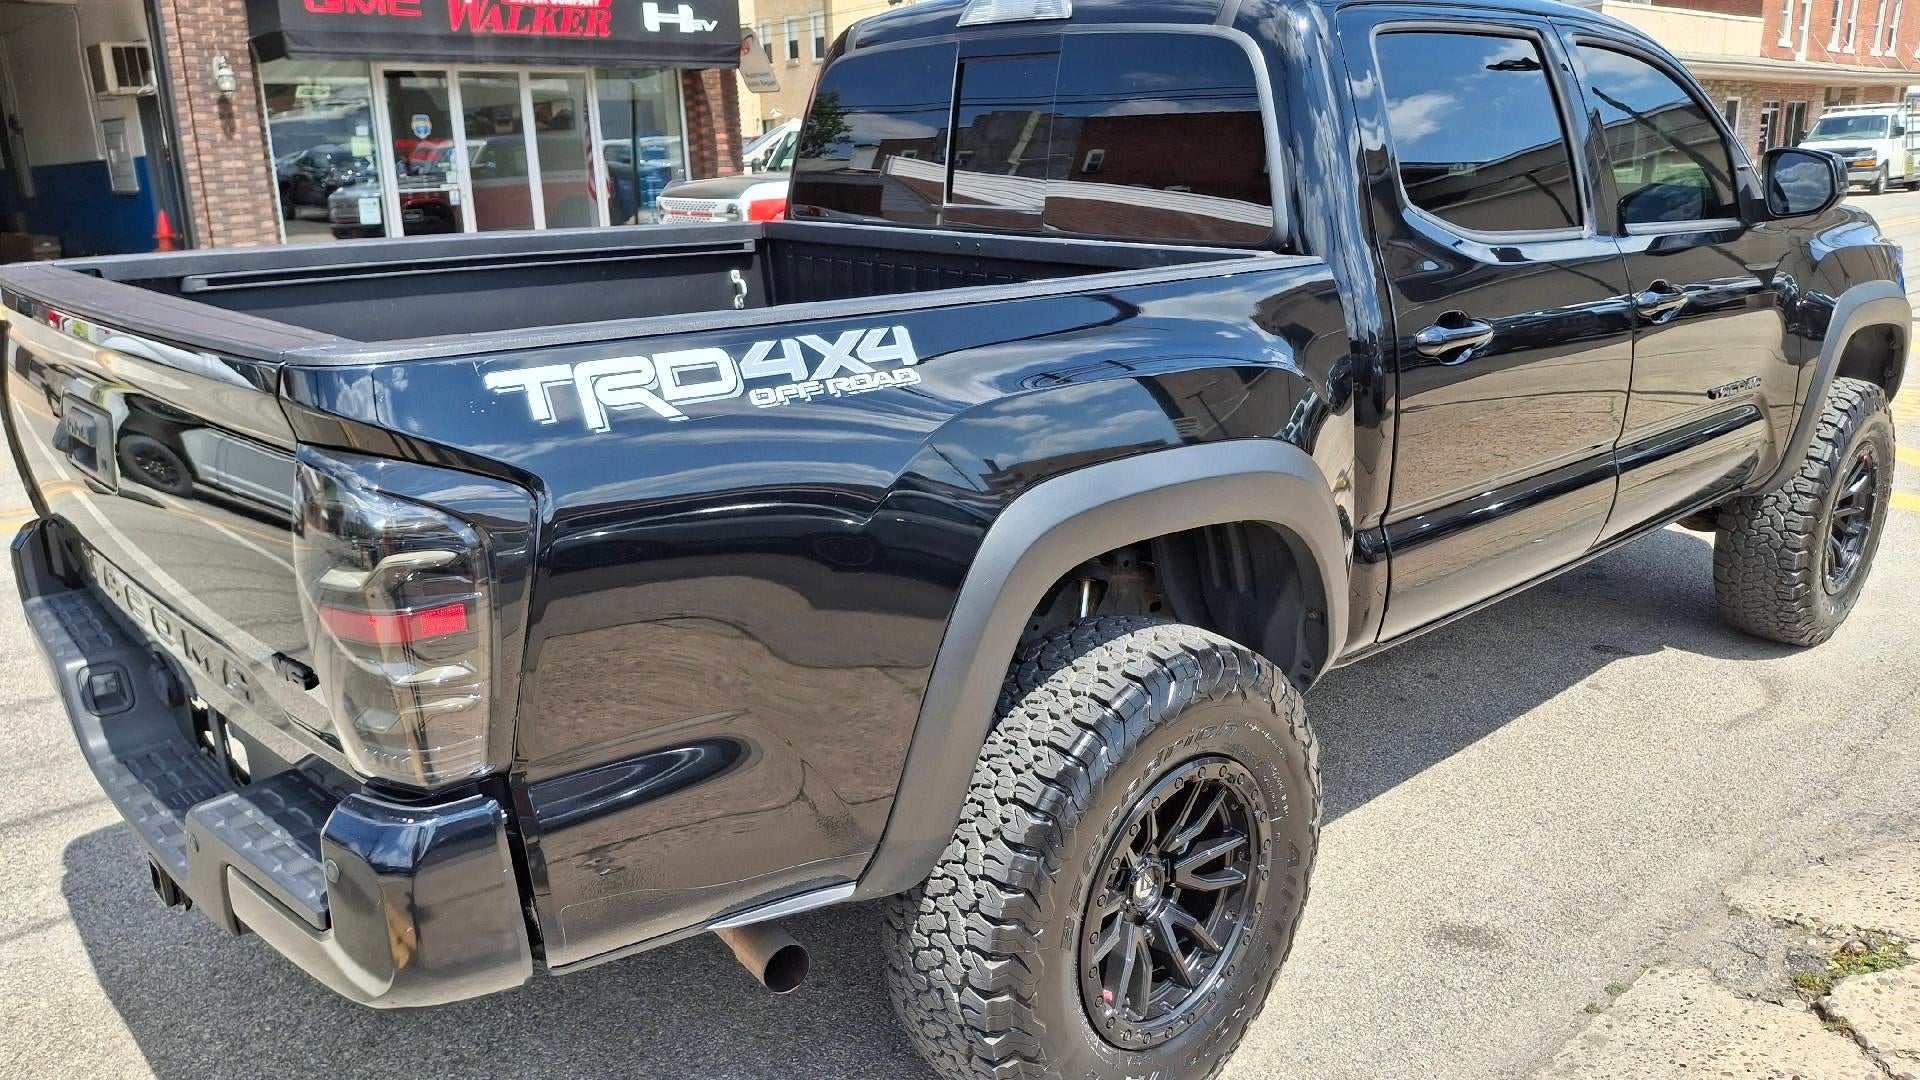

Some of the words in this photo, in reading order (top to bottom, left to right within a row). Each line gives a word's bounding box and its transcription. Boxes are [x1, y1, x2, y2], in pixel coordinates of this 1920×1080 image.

[448, 0, 612, 37] WALKER
[484, 347, 744, 433] TRD
[748, 381, 825, 408] OFF
[828, 367, 921, 398] ROAD
